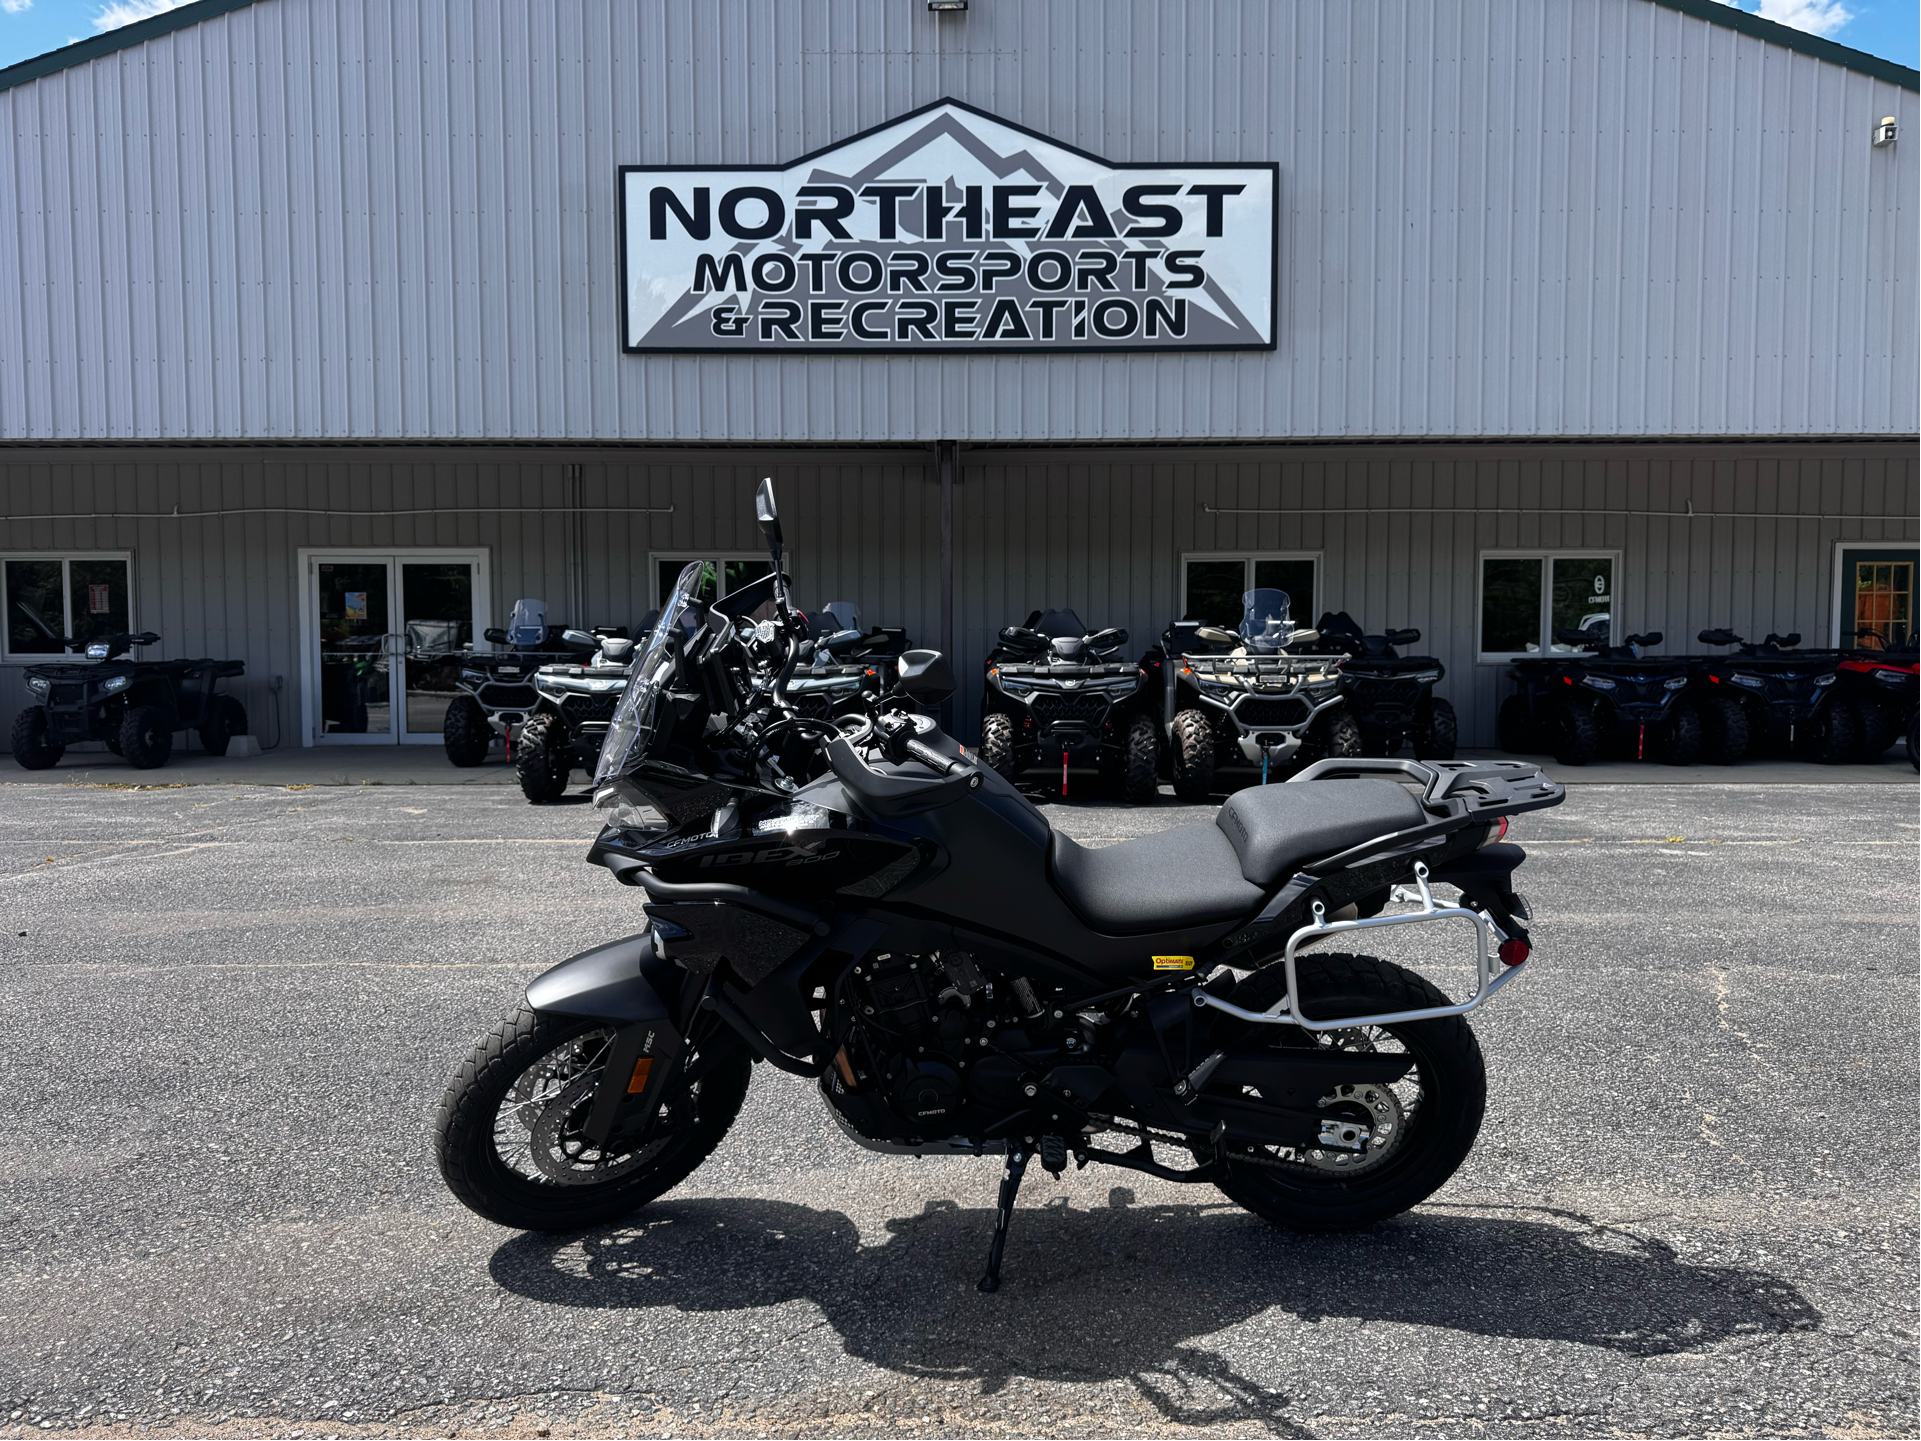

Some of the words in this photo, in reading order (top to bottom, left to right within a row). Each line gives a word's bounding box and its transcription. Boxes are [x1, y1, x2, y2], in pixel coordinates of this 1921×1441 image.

[648, 184, 1247, 241] NORTHEAST
[692, 250, 1205, 293] MOTORSPORTS
[1228, 806, 1249, 843] CFMOTO
[698, 841, 822, 868] IBEX
[643, 1030, 655, 1053] MSC
[917, 1108, 946, 1116] CFMOTO
